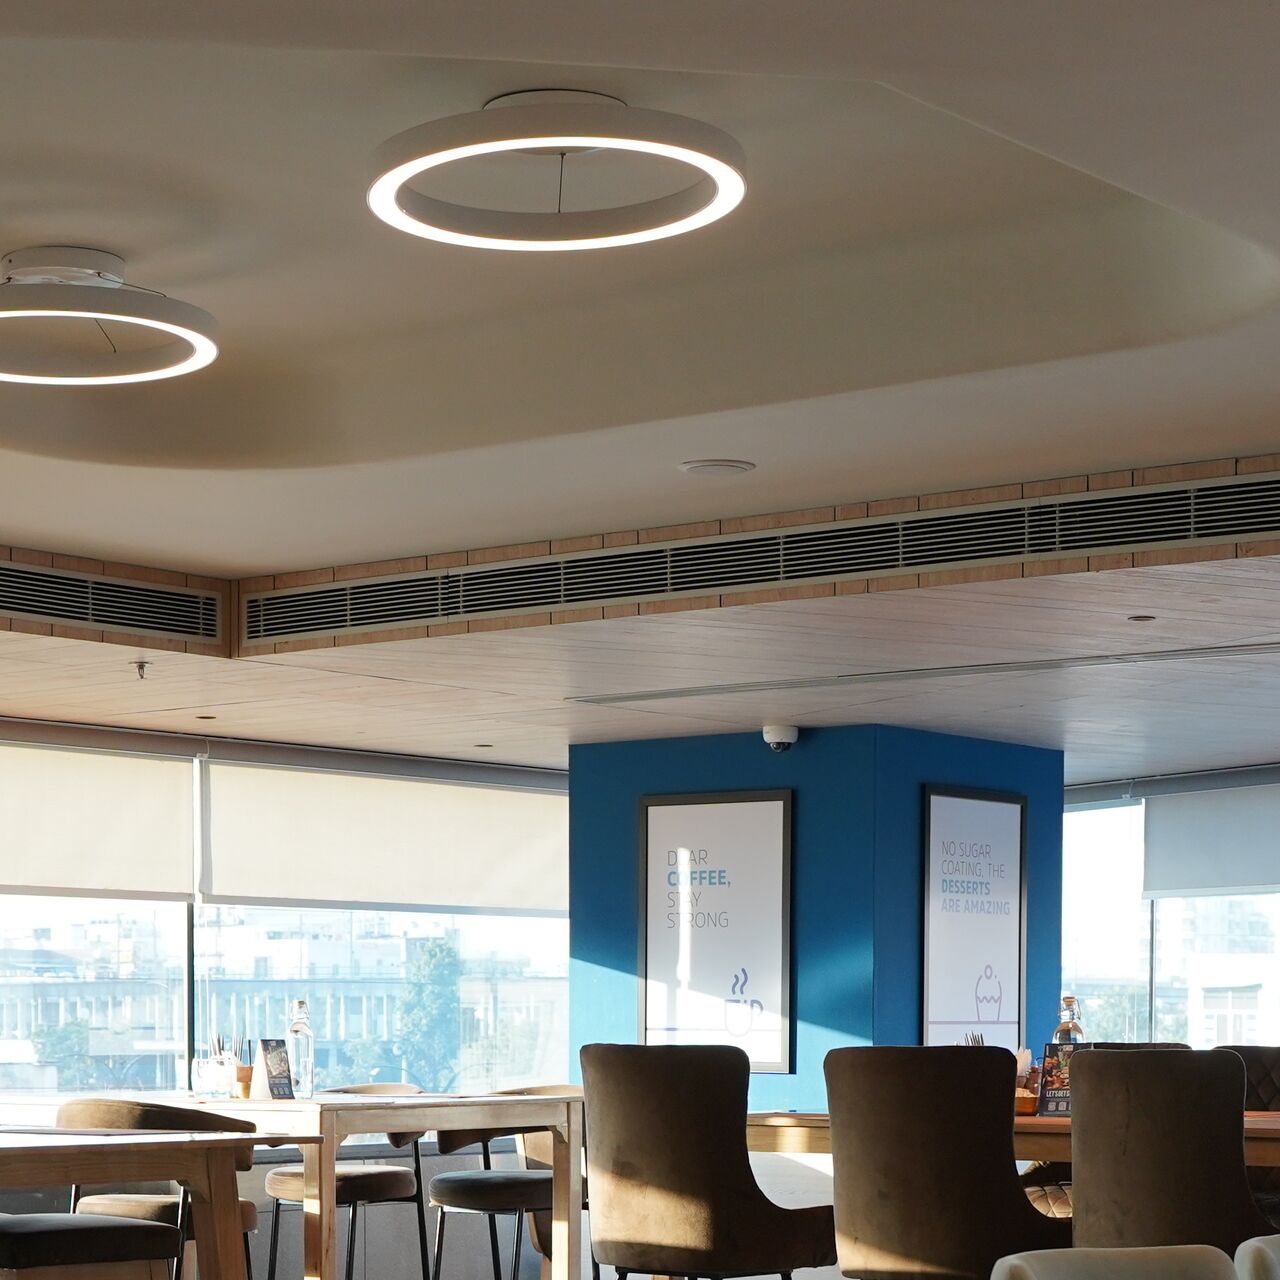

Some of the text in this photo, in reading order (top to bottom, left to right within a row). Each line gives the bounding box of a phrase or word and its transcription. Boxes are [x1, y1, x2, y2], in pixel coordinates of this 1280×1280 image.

[667, 849, 708, 867] DAR
[941, 840, 992, 858] NO SUGAR
[667, 870, 731, 887] CFFEE,
[941, 860, 1006, 879] COATING, THE
[942, 879, 991, 896] DESSERTS
[667, 891, 702, 908] SY
[941, 898, 1011, 916] ARE AMAZING
[667, 911, 729, 929] SRONG
